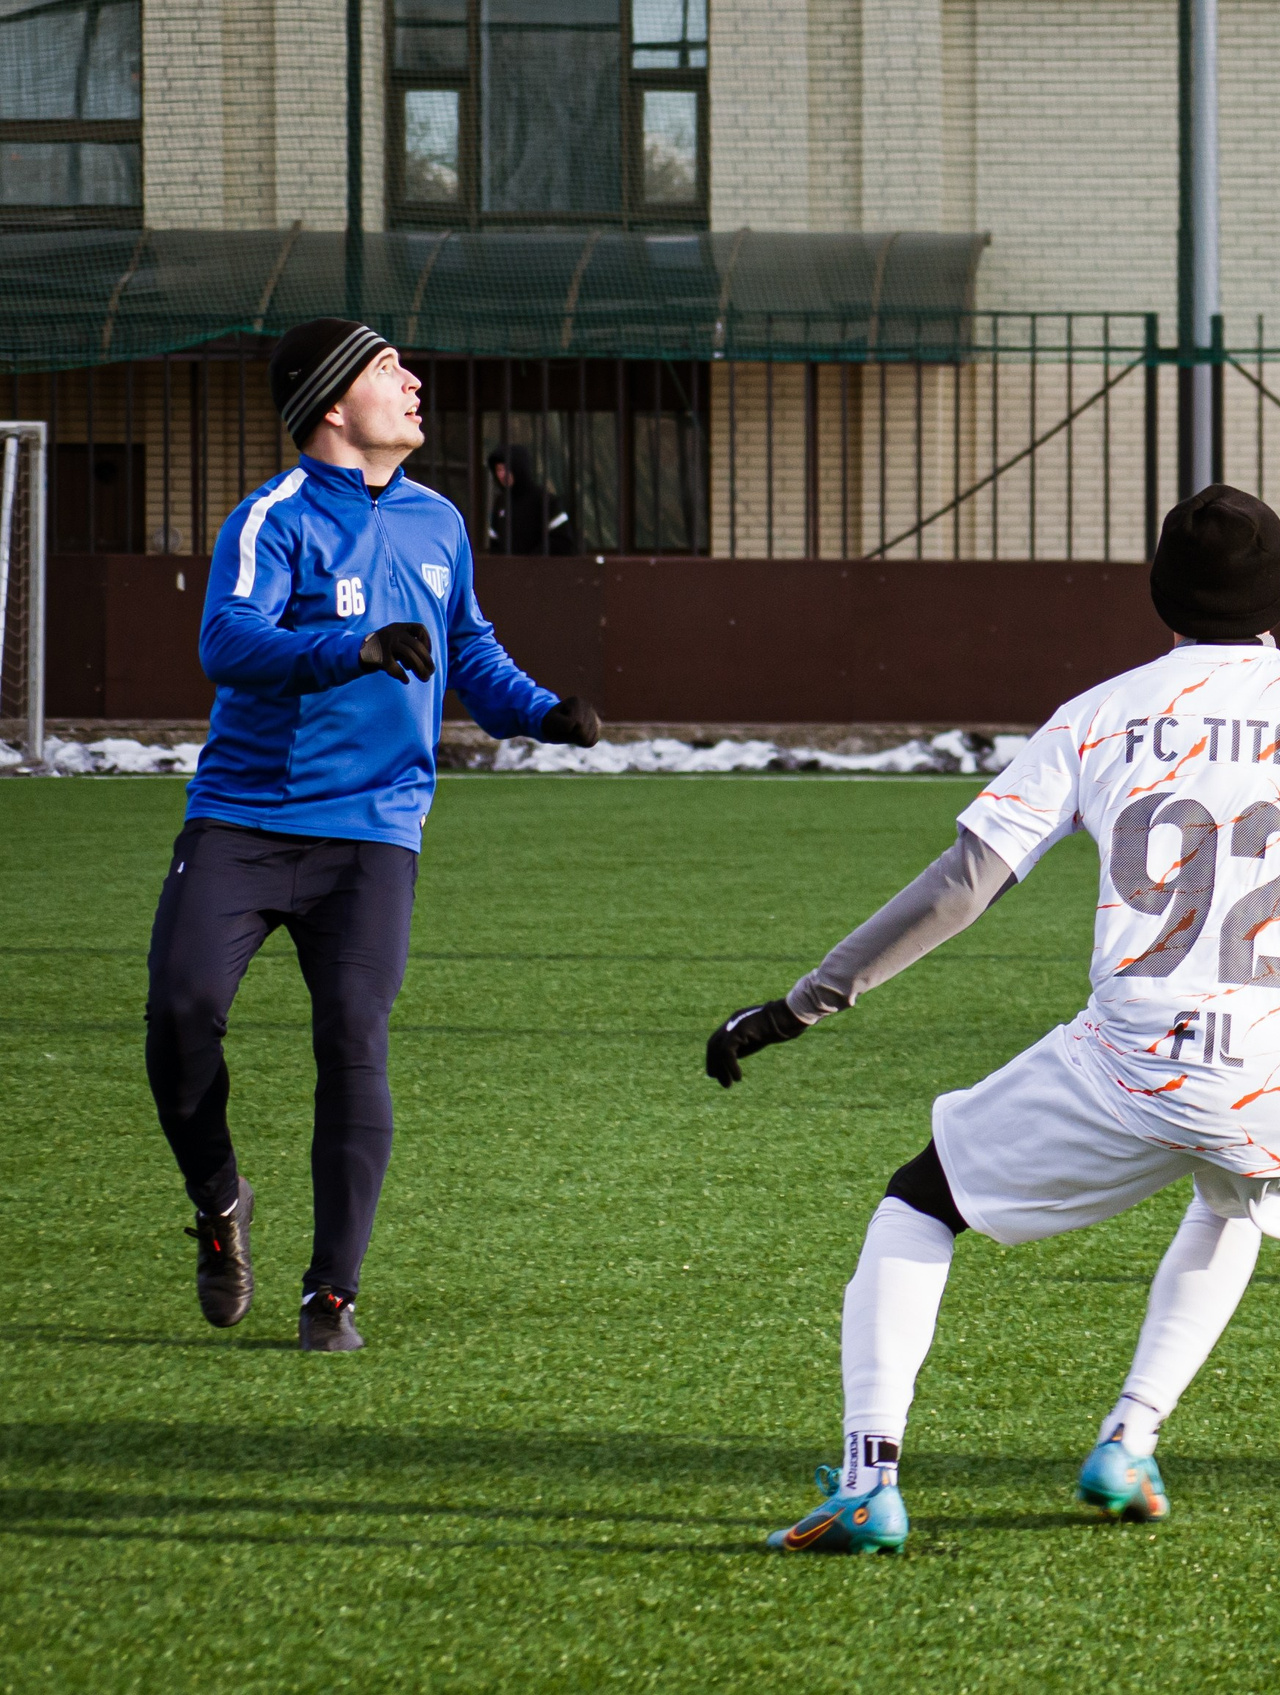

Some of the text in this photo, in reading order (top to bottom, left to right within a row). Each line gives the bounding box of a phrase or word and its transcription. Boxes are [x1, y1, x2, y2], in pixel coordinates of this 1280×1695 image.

[336, 576, 366, 617] 86
[1125, 717, 1180, 764] FC
[1170, 1010, 1245, 1067] FIL
